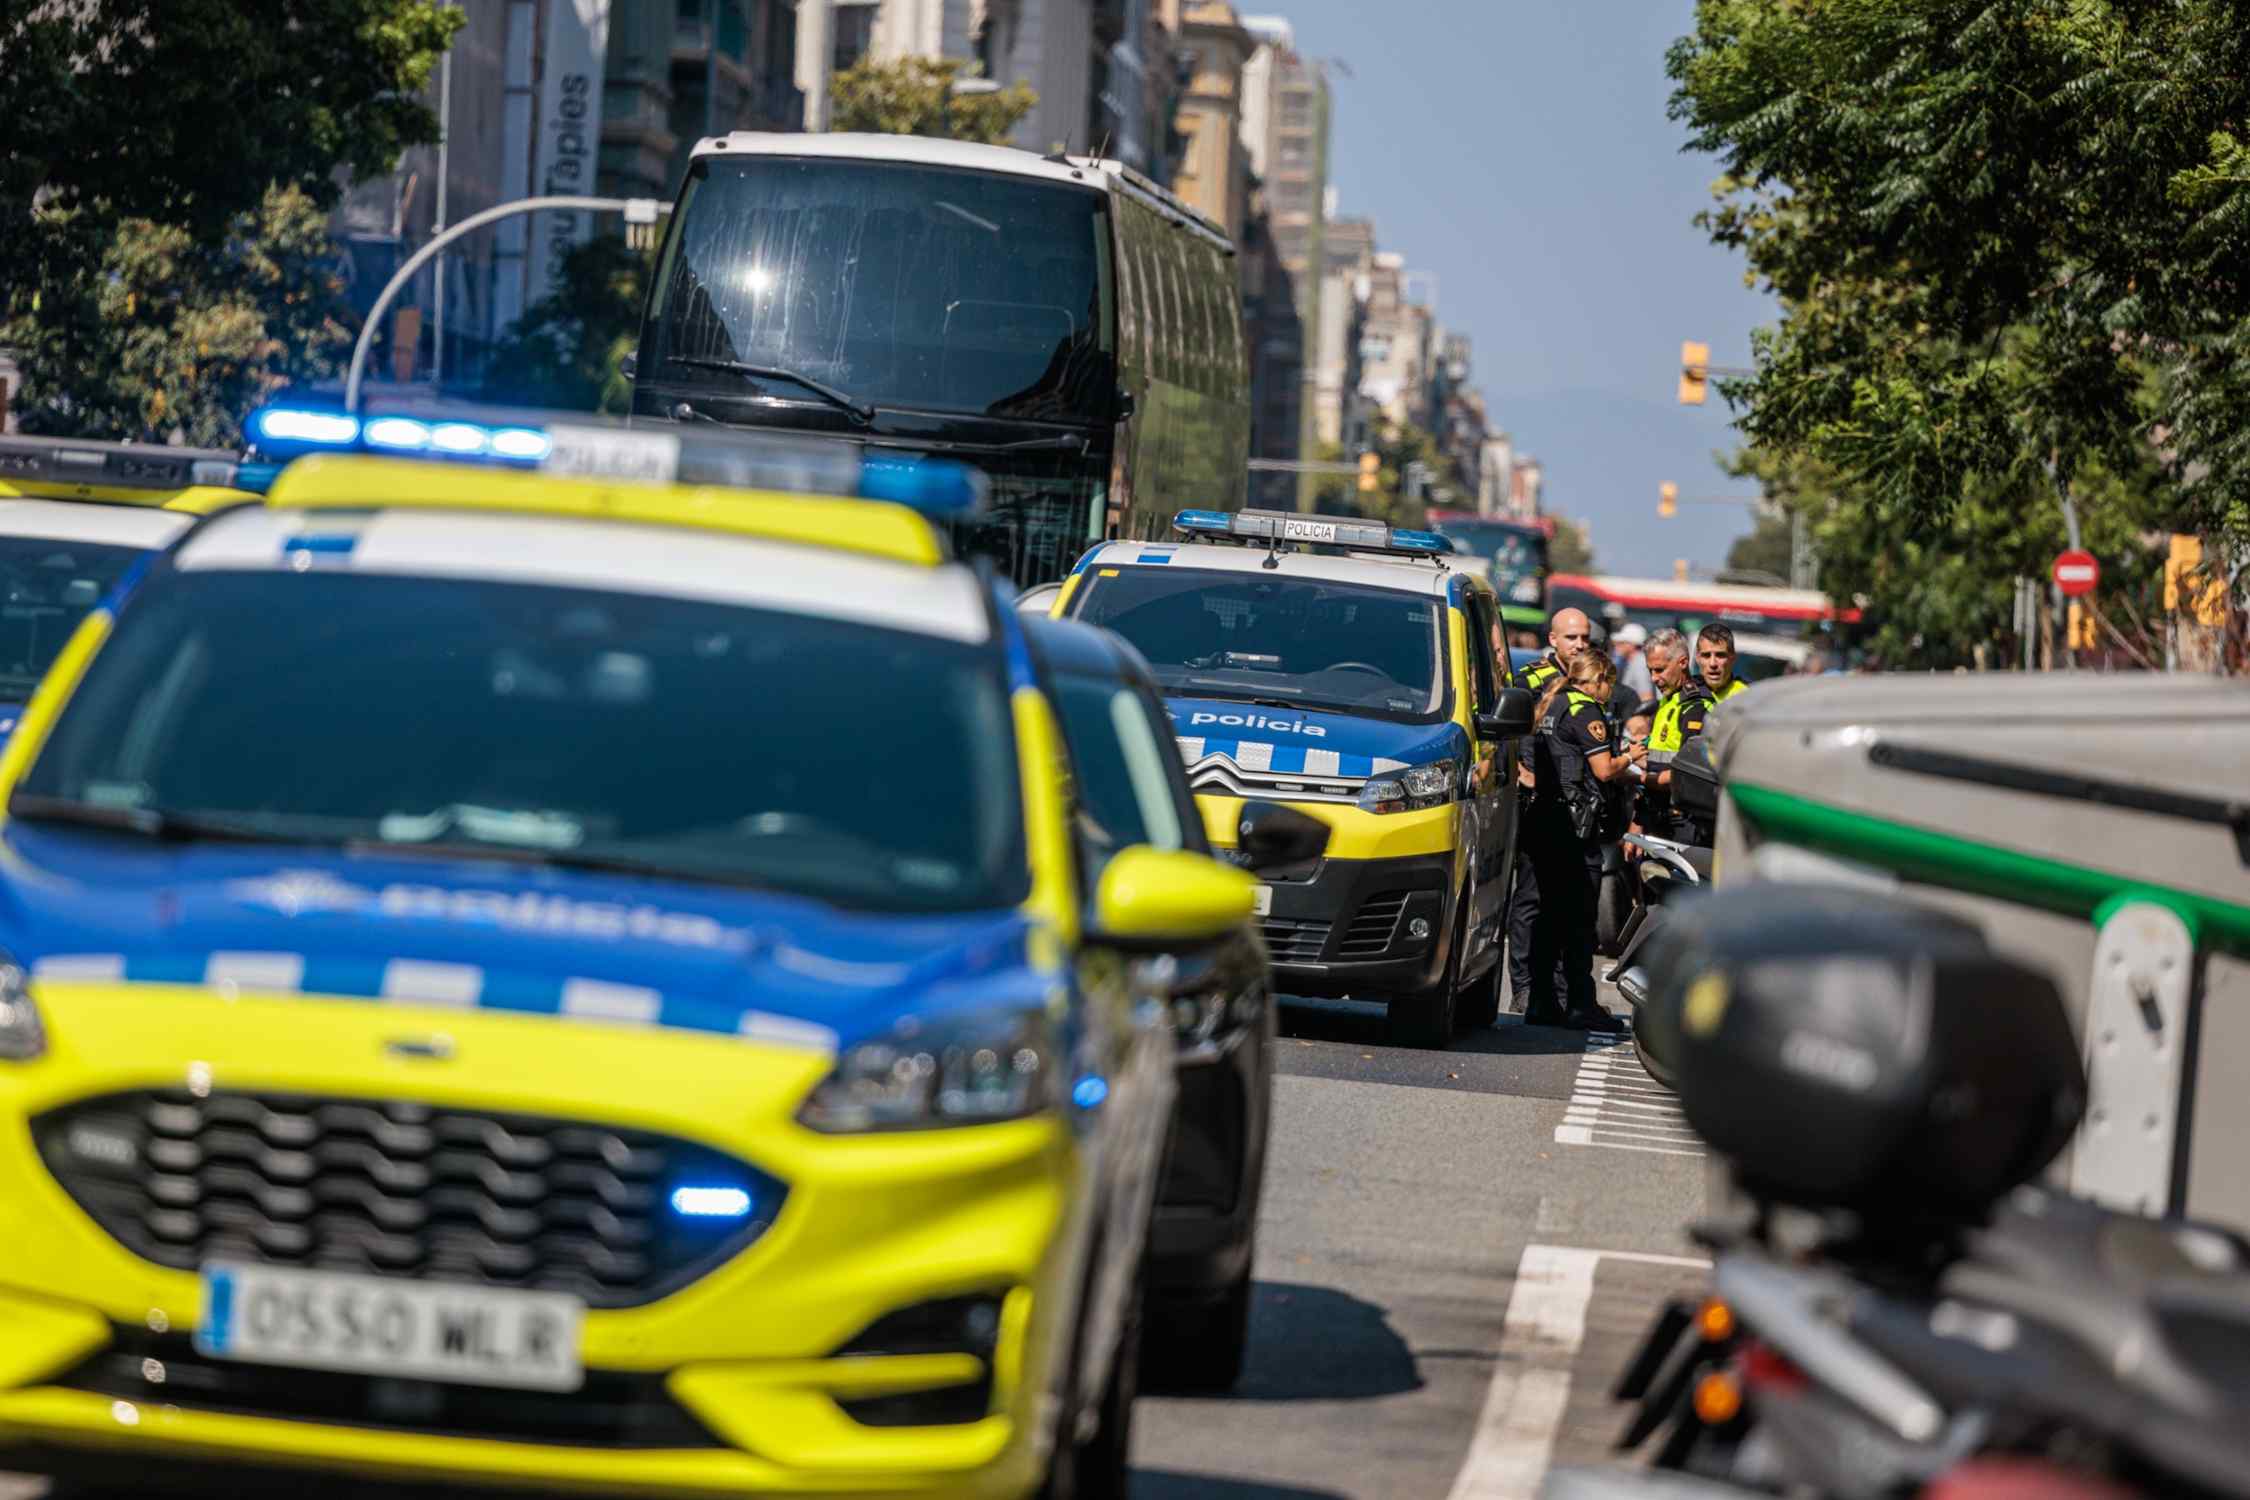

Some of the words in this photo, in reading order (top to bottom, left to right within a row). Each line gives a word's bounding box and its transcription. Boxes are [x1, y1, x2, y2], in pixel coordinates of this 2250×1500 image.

[545, 72, 589, 198] Tàpies
[1287, 522, 1332, 537] POLICIA
[1191, 712, 1327, 737] policia
